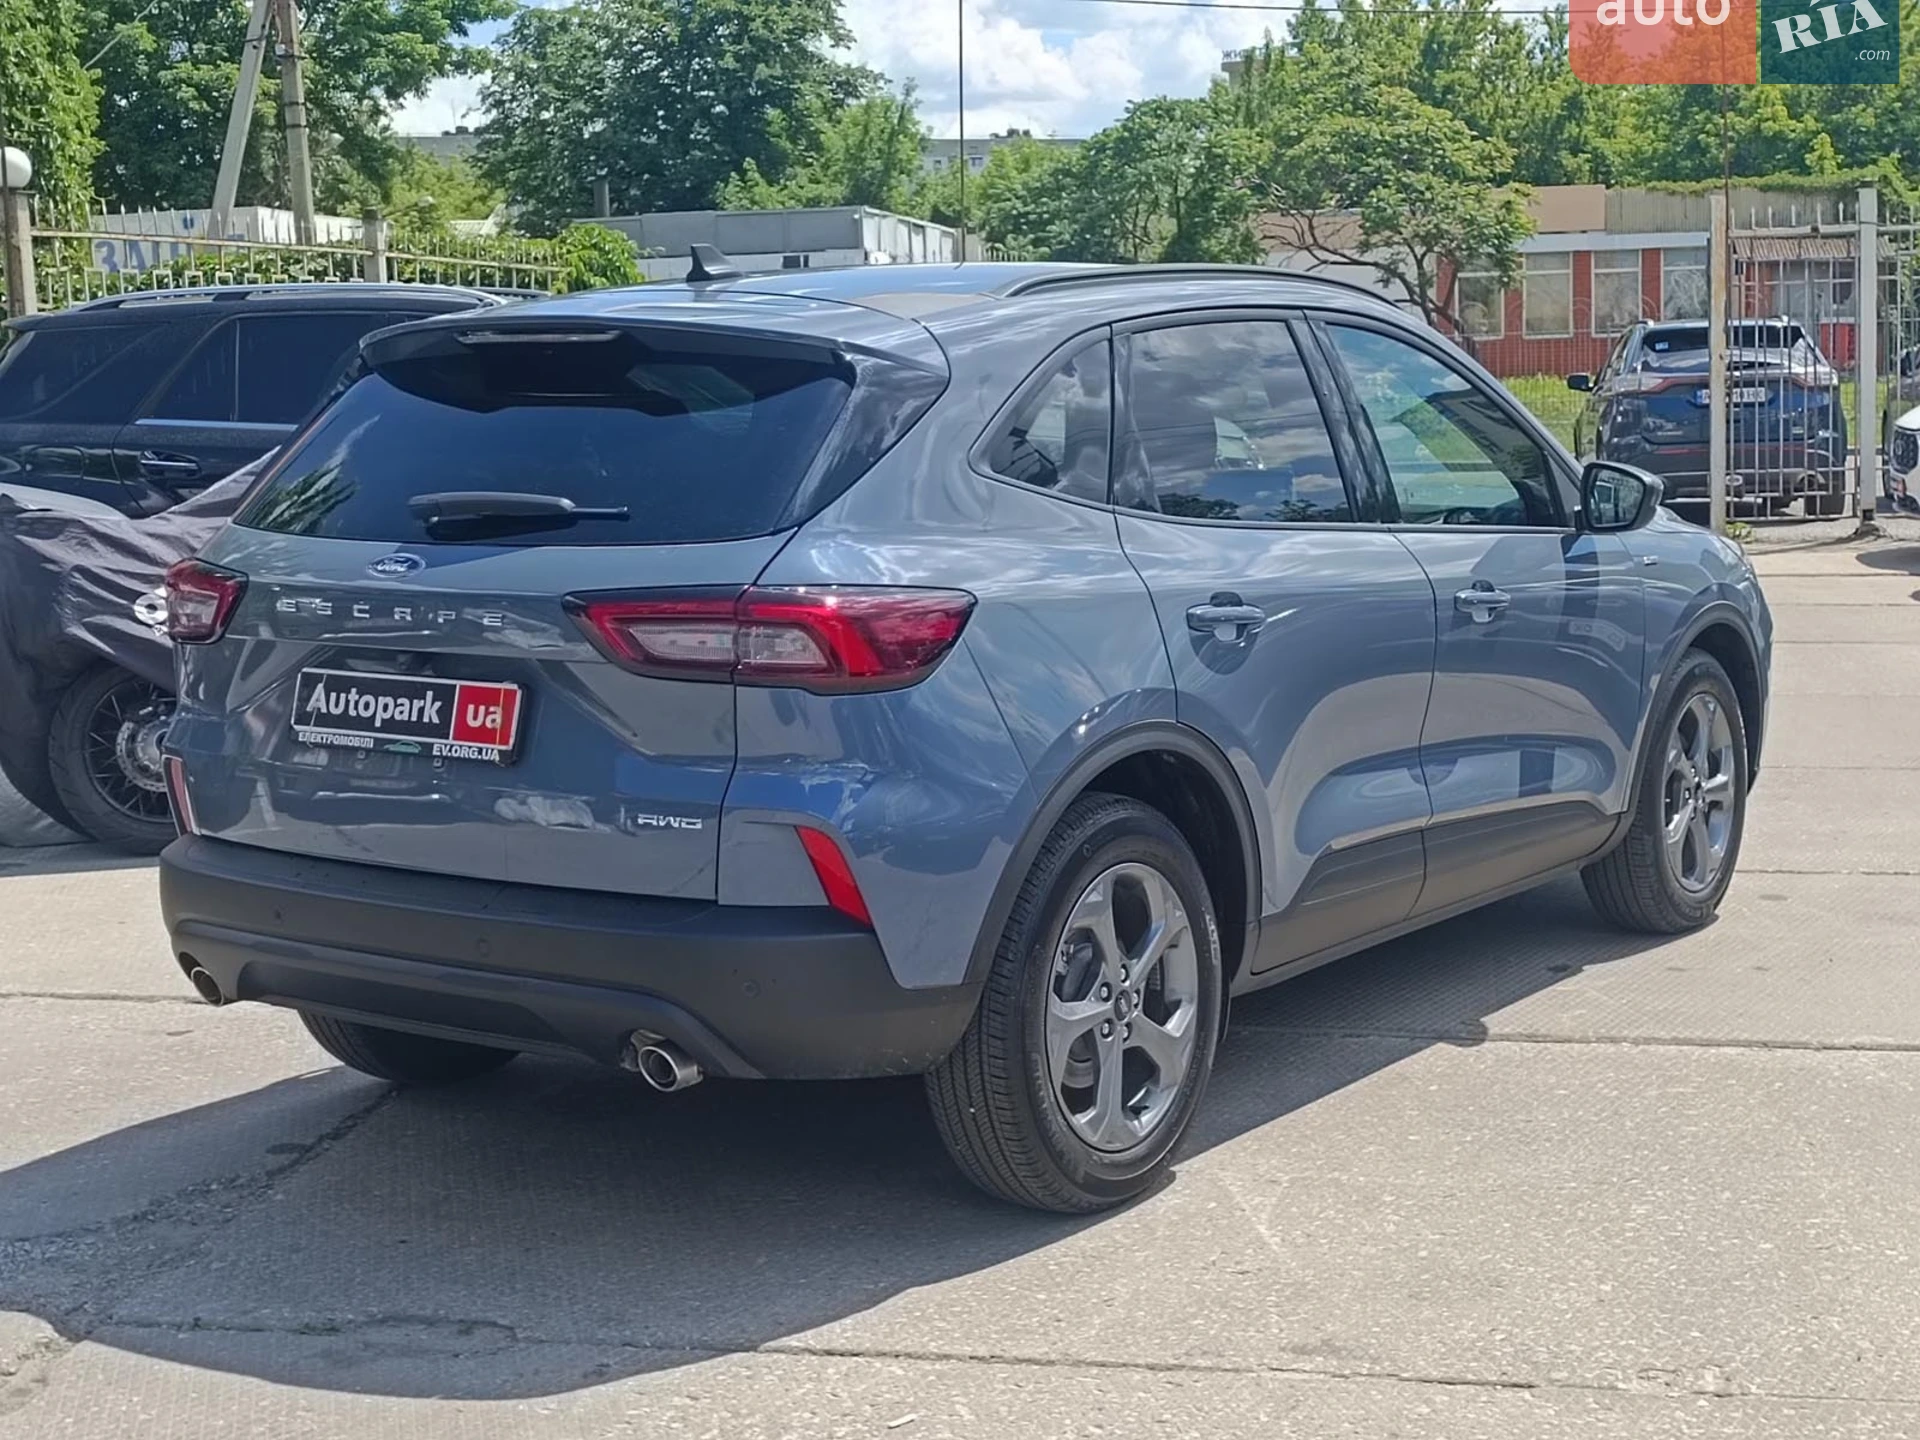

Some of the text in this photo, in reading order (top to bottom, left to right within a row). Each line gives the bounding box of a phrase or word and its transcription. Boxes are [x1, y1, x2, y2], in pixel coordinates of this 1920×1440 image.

[372, 556, 414, 573] Ford
[276, 598, 502, 626] ESCAPE
[306, 683, 503, 728] Autopark ua
[432, 743, 500, 761] EV.ORG.UA
[637, 813, 702, 829] AWD
